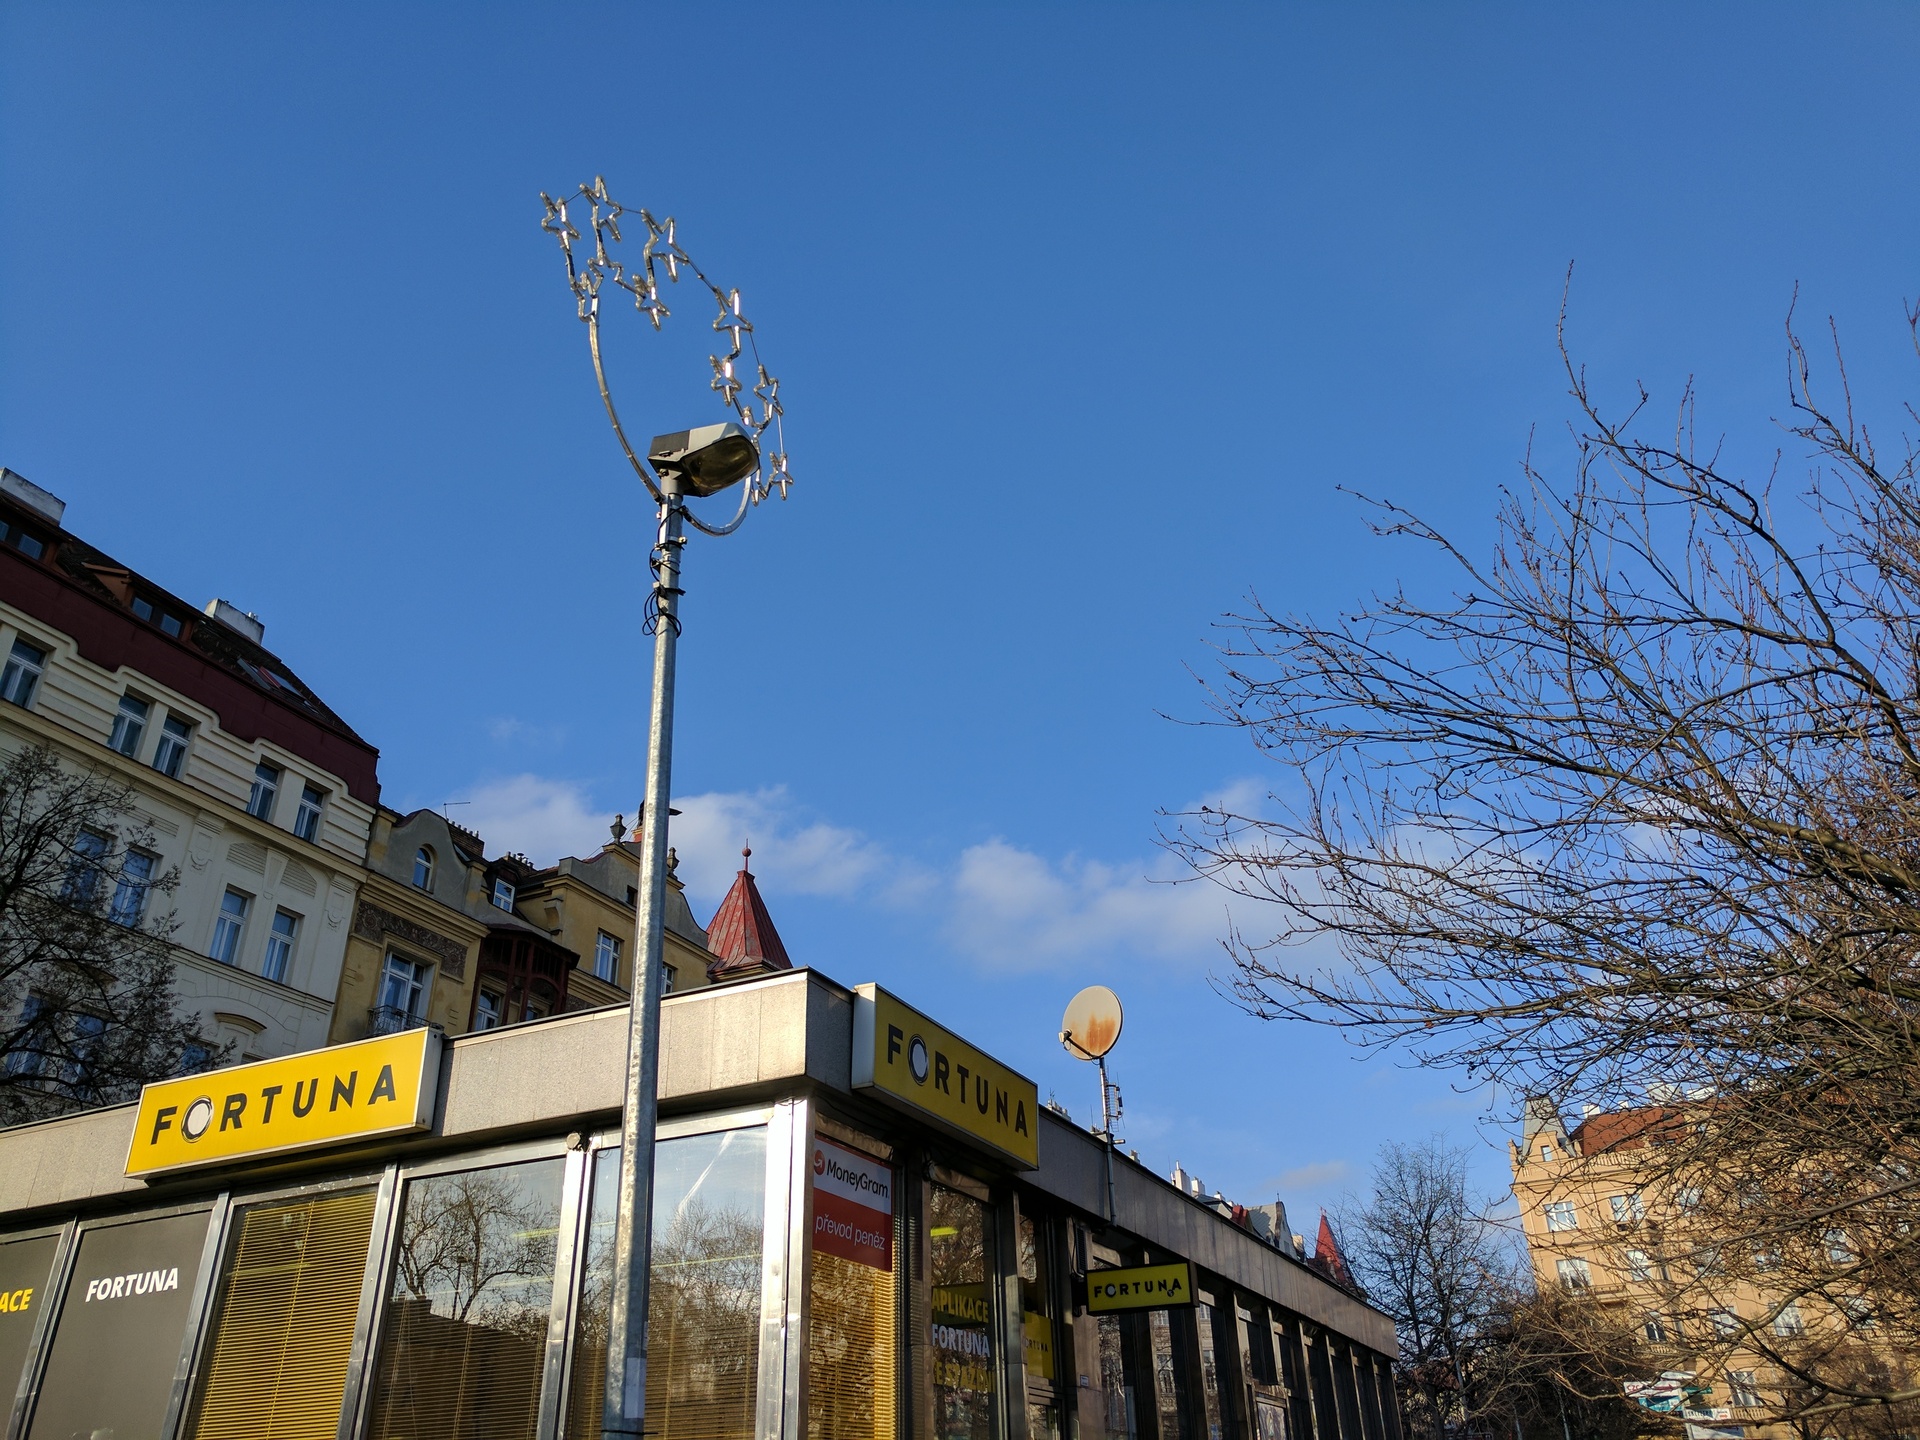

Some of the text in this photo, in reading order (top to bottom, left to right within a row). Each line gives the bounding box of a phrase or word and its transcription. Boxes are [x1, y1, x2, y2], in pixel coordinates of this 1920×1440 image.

[887, 1023, 1028, 1138] FORTUNA
[150, 1064, 397, 1145] FORTUNA
[826, 1158, 888, 1198] MoneyGram
[815, 1213, 885, 1250] převod peněz
[85, 1267, 179, 1303] FORTUNA
[1094, 1278, 1182, 1298] FORTUNA
[932, 1287, 989, 1324] APLIKACE
[932, 1323, 991, 1357] FORTUNA
[932, 1361, 943, 1385] E
